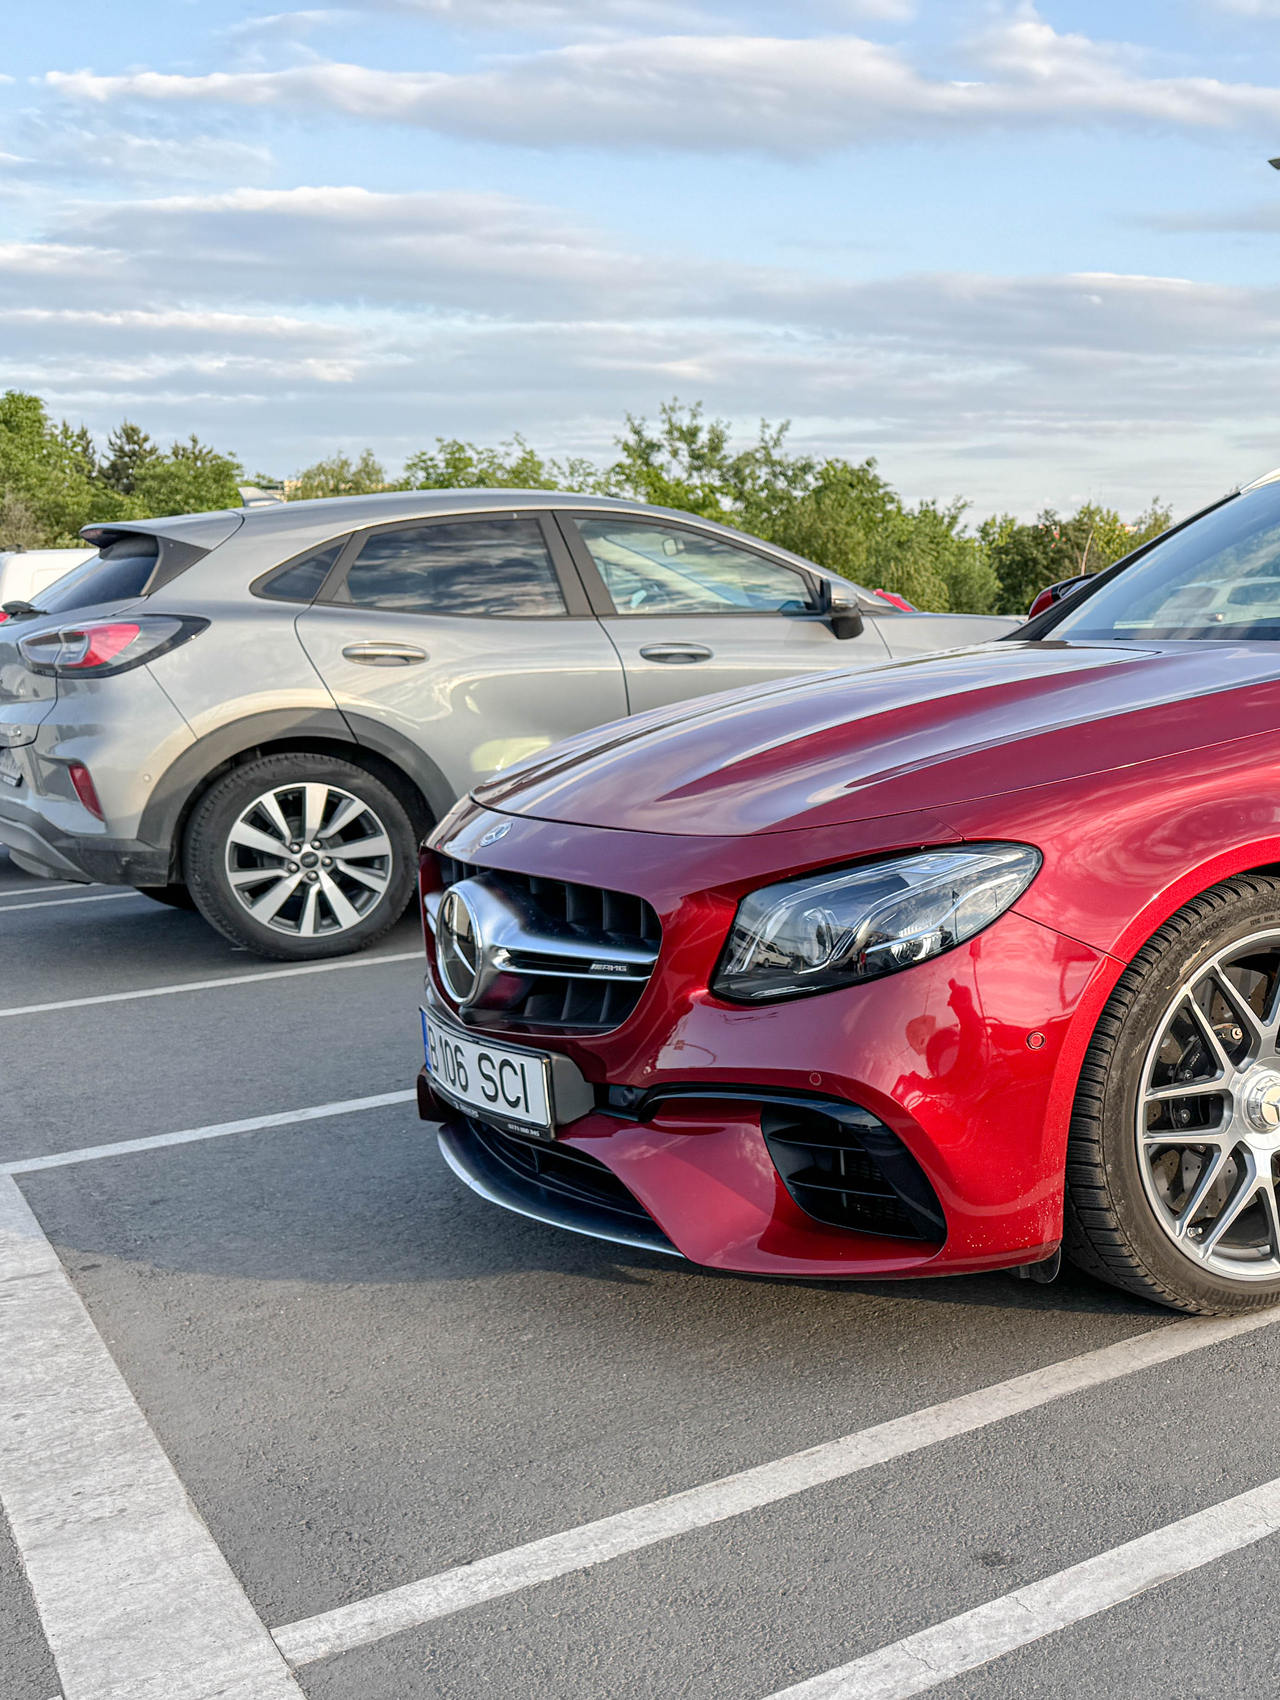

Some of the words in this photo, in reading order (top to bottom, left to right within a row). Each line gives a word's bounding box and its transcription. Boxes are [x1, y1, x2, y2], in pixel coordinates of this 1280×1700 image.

[1198, 921, 1219, 939] 860
[428, 1024, 439, 1073] B
[439, 1034, 469, 1093] 106
[478, 1052, 530, 1113] SCI
